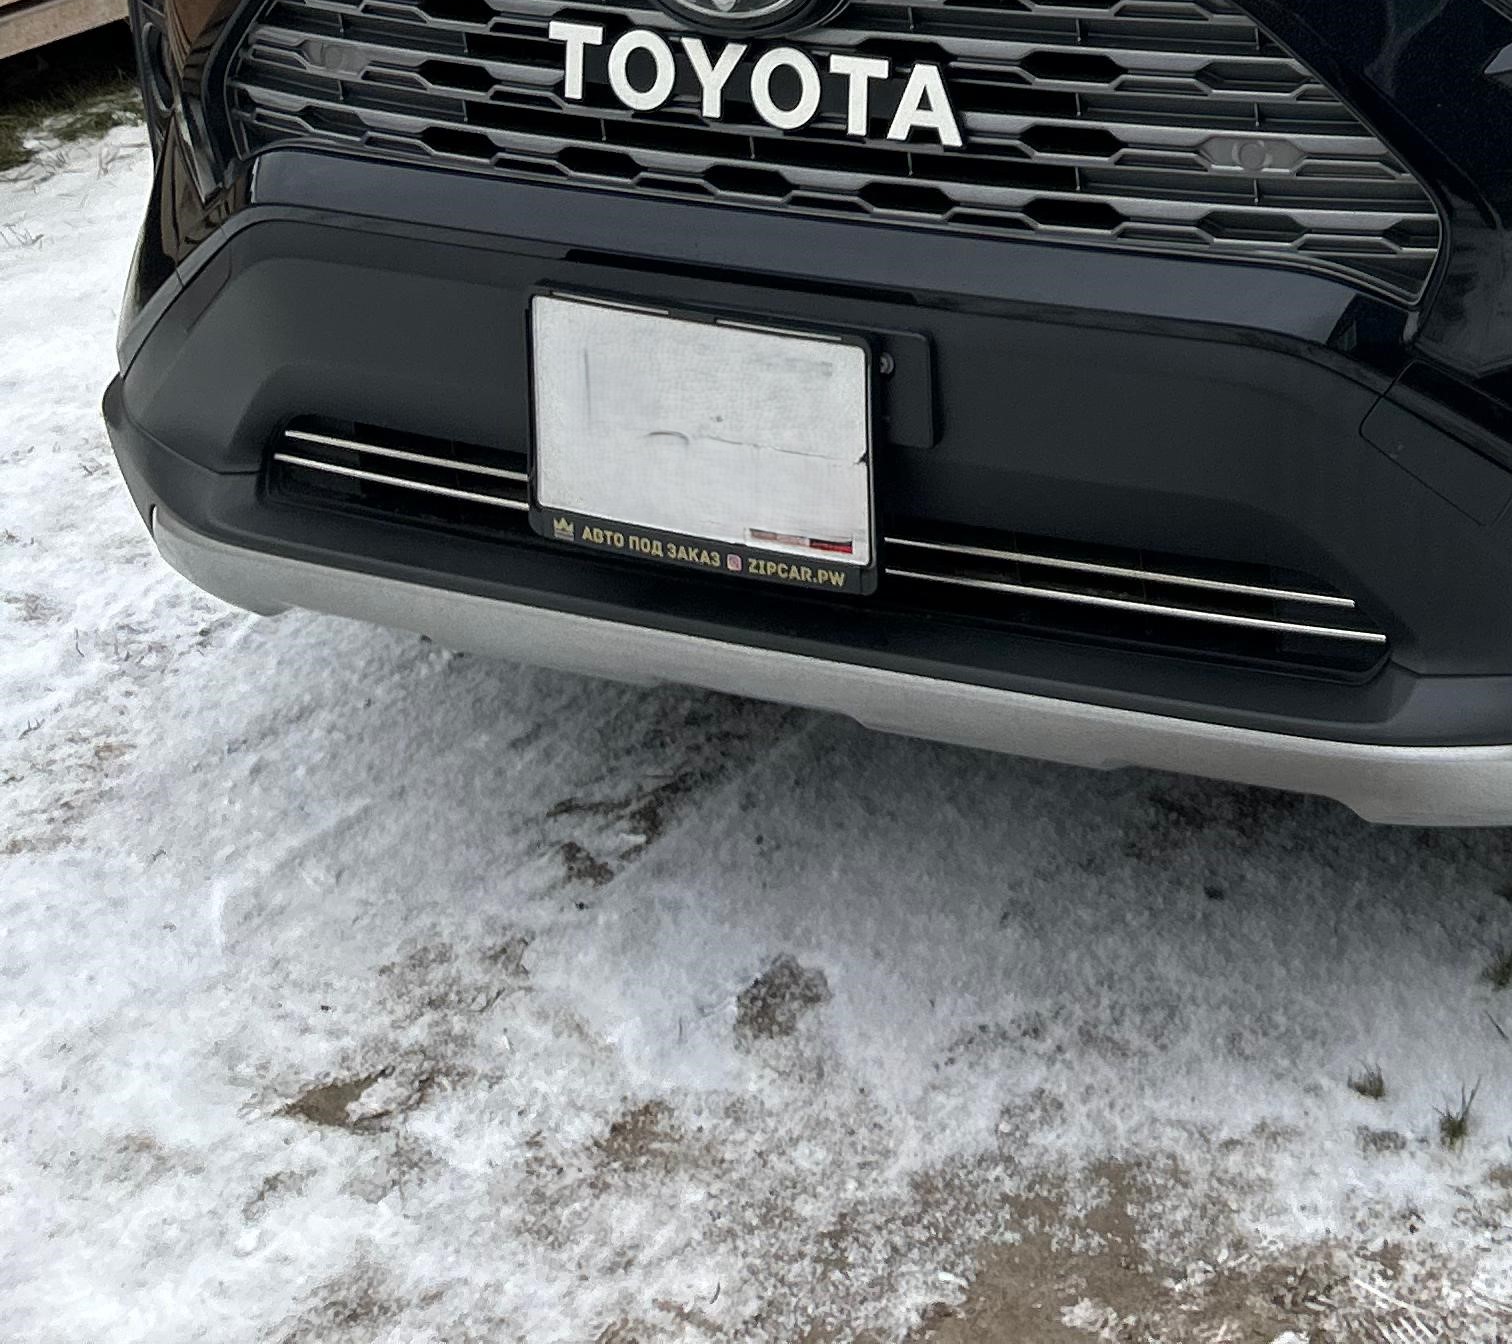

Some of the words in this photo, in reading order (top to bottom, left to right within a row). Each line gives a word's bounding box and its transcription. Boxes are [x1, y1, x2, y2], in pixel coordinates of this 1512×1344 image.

[549, 20, 963, 148] TOYOTA
[581, 525, 625, 548] АВТО
[628, 535, 664, 558] ПОД
[667, 542, 721, 567] ЗАКАЗ
[747, 557, 846, 587] ZIPCAR.PW
